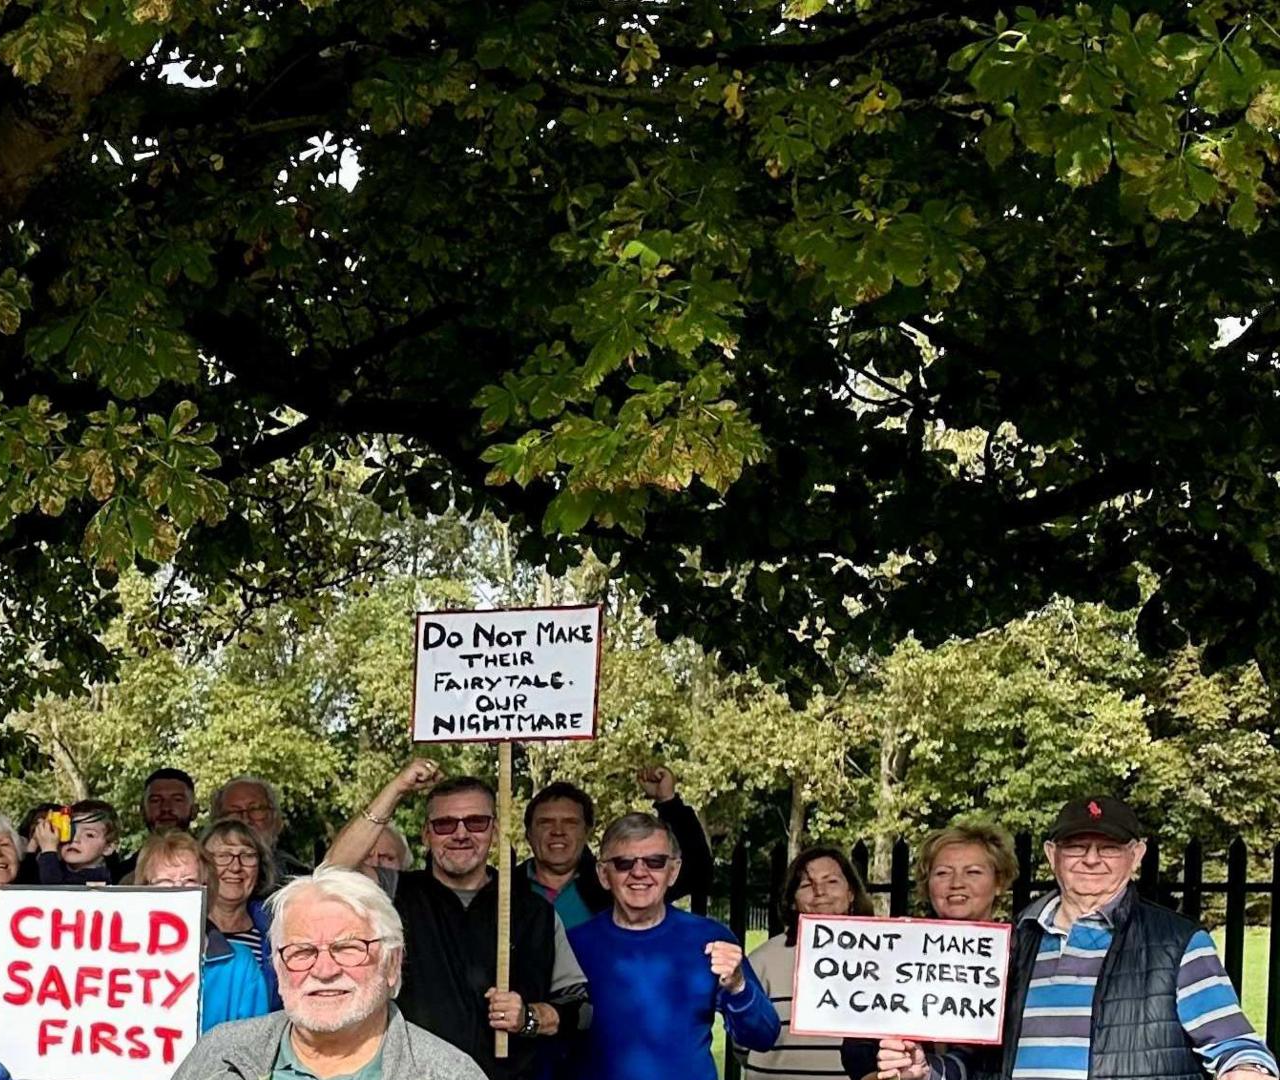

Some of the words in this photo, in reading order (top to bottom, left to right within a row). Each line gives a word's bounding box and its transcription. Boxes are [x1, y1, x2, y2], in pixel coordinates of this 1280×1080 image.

[537, 620, 593, 646] MAKE
[459, 651, 534, 668] THEIR
[475, 693, 528, 713] OUR
[432, 712, 583, 736] NIGHTMARE
[10, 906, 189, 956] CHILD
[812, 924, 902, 951] DONT
[922, 932, 994, 958] MAKE
[3, 960, 195, 1011] SAFETY
[814, 957, 880, 982] OUR
[895, 962, 1001, 988] STREETS
[816, 989, 839, 1009] A
[849, 990, 910, 1014] CAR
[921, 993, 998, 1019] PARK
[37, 1019, 183, 1064] FIRST
